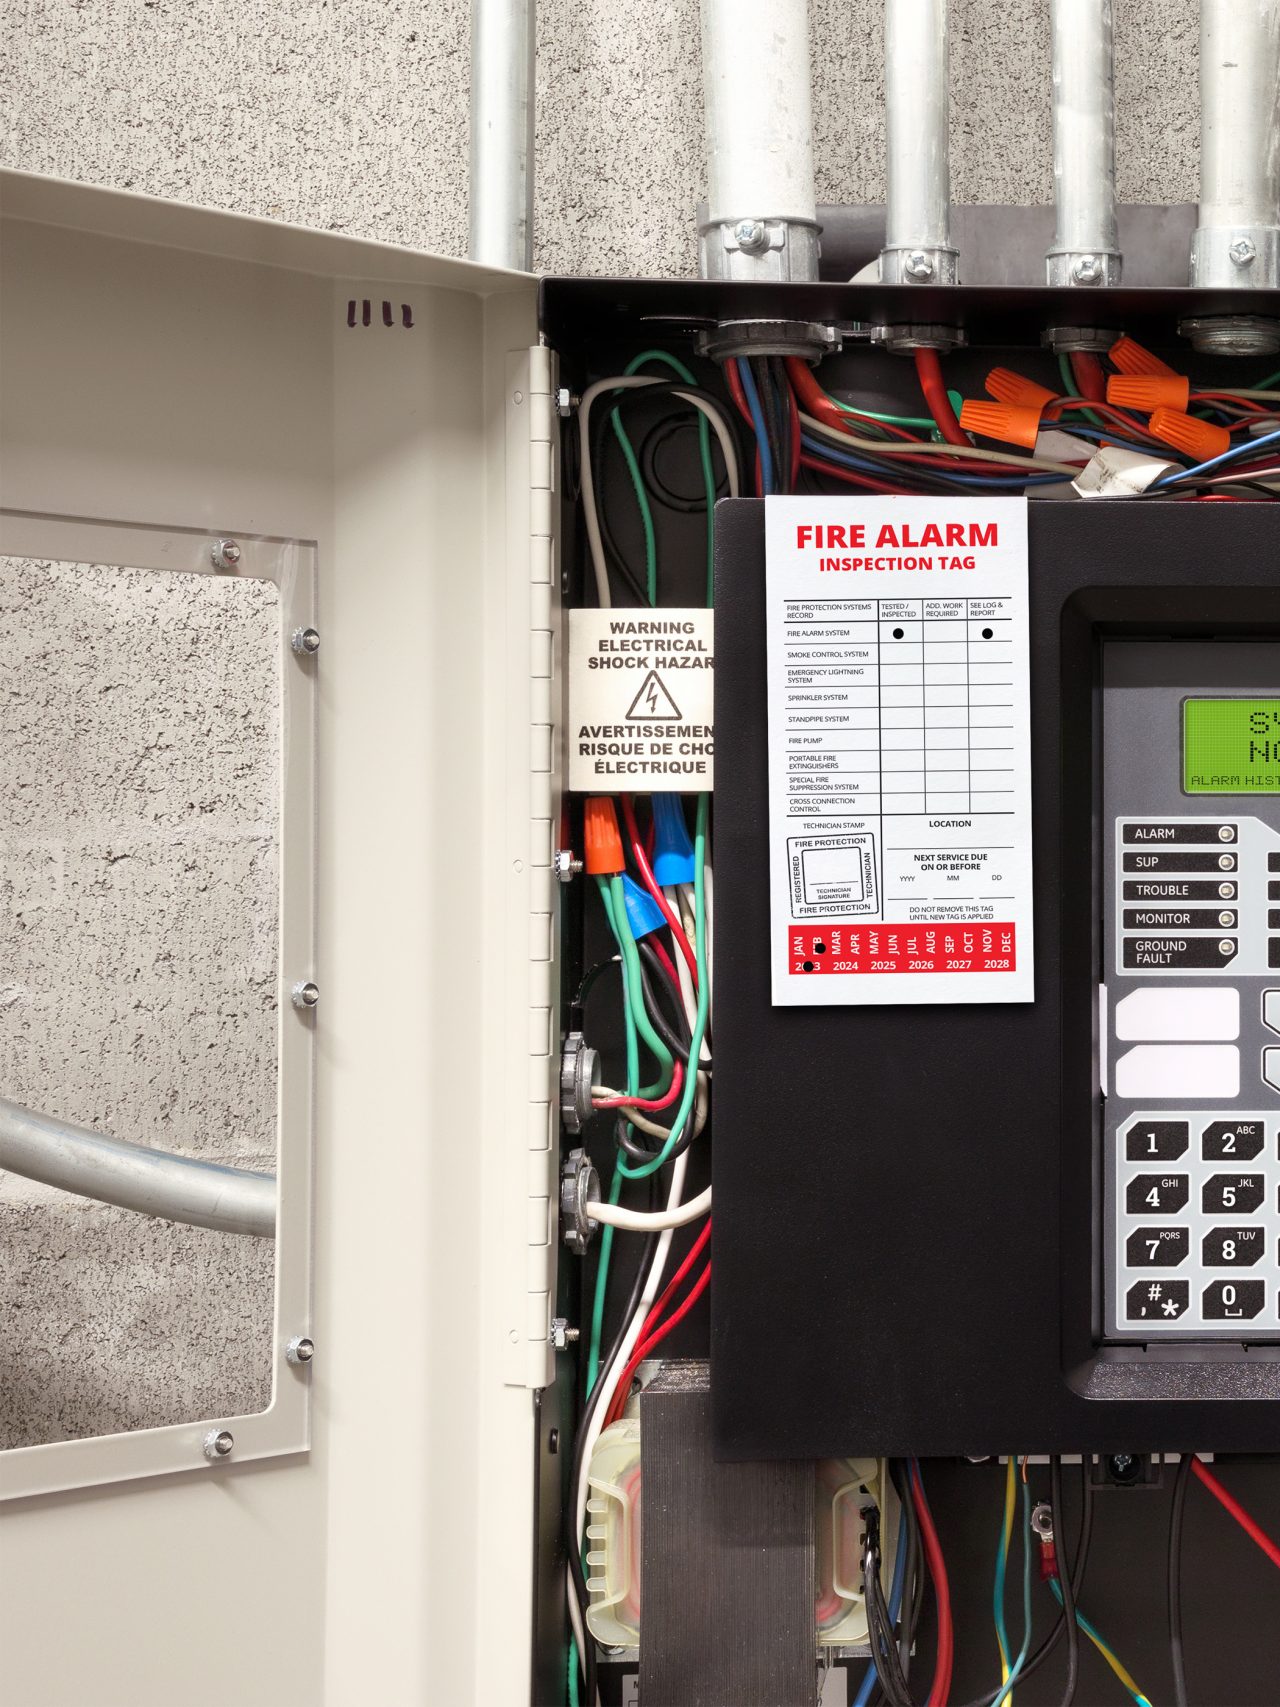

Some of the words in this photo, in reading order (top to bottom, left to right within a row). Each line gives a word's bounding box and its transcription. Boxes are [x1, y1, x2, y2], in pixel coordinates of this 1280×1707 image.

[797, 525, 865, 549] FIRE
[876, 523, 997, 548] ALARM
[820, 557, 932, 571] INSPECTION
[938, 556, 975, 570] TAG
[610, 622, 694, 634] WARNING
[599, 640, 707, 652] ELECTRICAL
[588, 657, 649, 669] SHOCK
[656, 657, 713, 668] HAZAR
[579, 726, 713, 738] AVERTISSEMEN
[579, 743, 644, 756] RISQUE
[651, 743, 672, 755] DE
[679, 743, 713, 755] CHO
[595, 759, 706, 774] ÉLECTRIQUE
[1192, 776, 1239, 786] ALARM
[1135, 829, 1174, 838] ALARM
[795, 840, 813, 848] FIRE
[815, 838, 866, 846] PROTECTION
[1136, 857, 1158, 867] SUP
[793, 855, 802, 903] REGISTERED
[863, 853, 873, 898] TECHNICIAN
[1136, 885, 1188, 895] TROUBLE
[820, 904, 870, 912] PROTECTION
[1136, 914, 1190, 923] MONITOR
[794, 937, 805, 956] JAN
[832, 931, 840, 954] MAR
[851, 934, 860, 954] APR
[870, 931, 878, 954] MAY
[888, 935, 900, 955] JUN
[907, 937, 918, 955] JUL
[926, 932, 935, 953] AUG
[945, 936, 954, 953] SEP
[964, 932, 973, 953] OCT
[983, 929, 992, 952] NOV
[1002, 933, 1011, 952] DEC
[1136, 941, 1186, 951] GROUND
[833, 962, 858, 970] 2024
[871, 961, 896, 969] 2025
[909, 961, 934, 969] 2026
[947, 960, 971, 968] 2027
[984, 960, 1009, 968] 2028
[1137, 953, 1172, 963] FAULT
[1237, 1126, 1255, 1134] ABC
[1148, 1133, 1158, 1152] 1
[1221, 1132, 1236, 1152] 2
[1162, 1179, 1178, 1187] GHI
[1238, 1179, 1254, 1187] JKL
[1146, 1186, 1160, 1207] 4
[1222, 1186, 1236, 1207] 5
[1159, 1232, 1180, 1241] PQRS
[1237, 1232, 1255, 1240] TUV
[1145, 1240, 1160, 1260] 7
[1222, 1240, 1235, 1259] 8
[1222, 1285, 1235, 1305] 0
